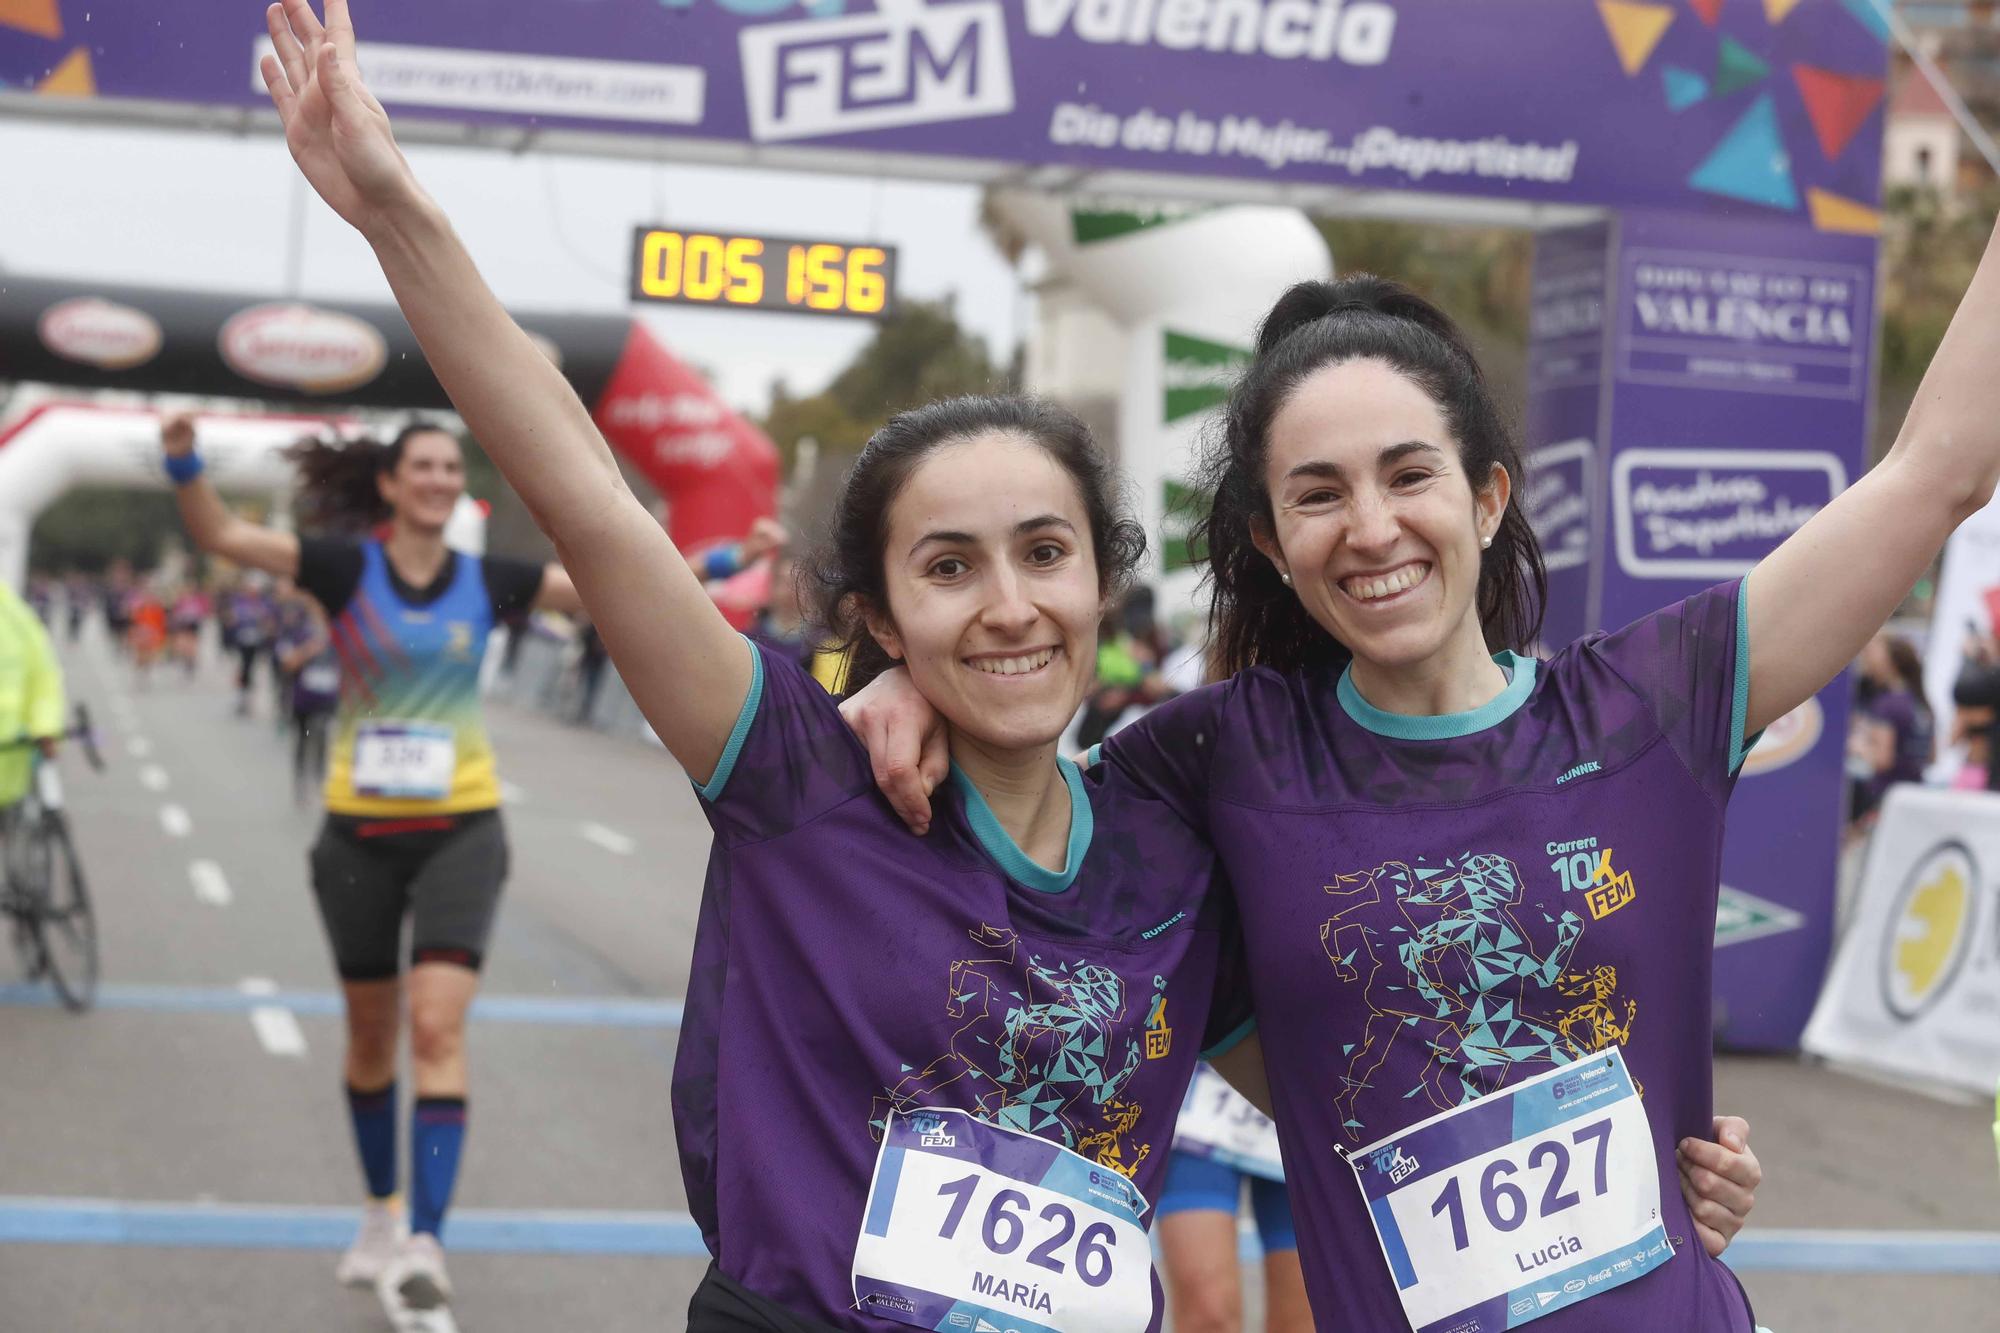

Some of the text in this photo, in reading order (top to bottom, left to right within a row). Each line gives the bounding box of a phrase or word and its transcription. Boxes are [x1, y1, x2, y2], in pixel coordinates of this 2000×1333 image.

[774, 20, 978, 121] FEM
[1121, 107, 1174, 153] de
[1174, 110, 1217, 156] la
[1556, 761, 1602, 785] RUNNEK
[1546, 837, 1597, 856] Carrera
[1551, 848, 1617, 892] 10K
[1591, 878, 1632, 916] FEM
[1141, 911, 1186, 940] RUNNEK
[1552, 1082, 1566, 1100] 6
[923, 1136, 954, 1146] FEM
[1369, 1144, 1394, 1159] Carrera
[1089, 1171, 1100, 1185] 6
[1392, 1158, 1417, 1182] FEM
[1431, 1118, 1613, 1252] 1627
[937, 1174, 1117, 1288] 1626
[1515, 1234, 1583, 1273] Lucía
[971, 1272, 1053, 1315] MARÍA
